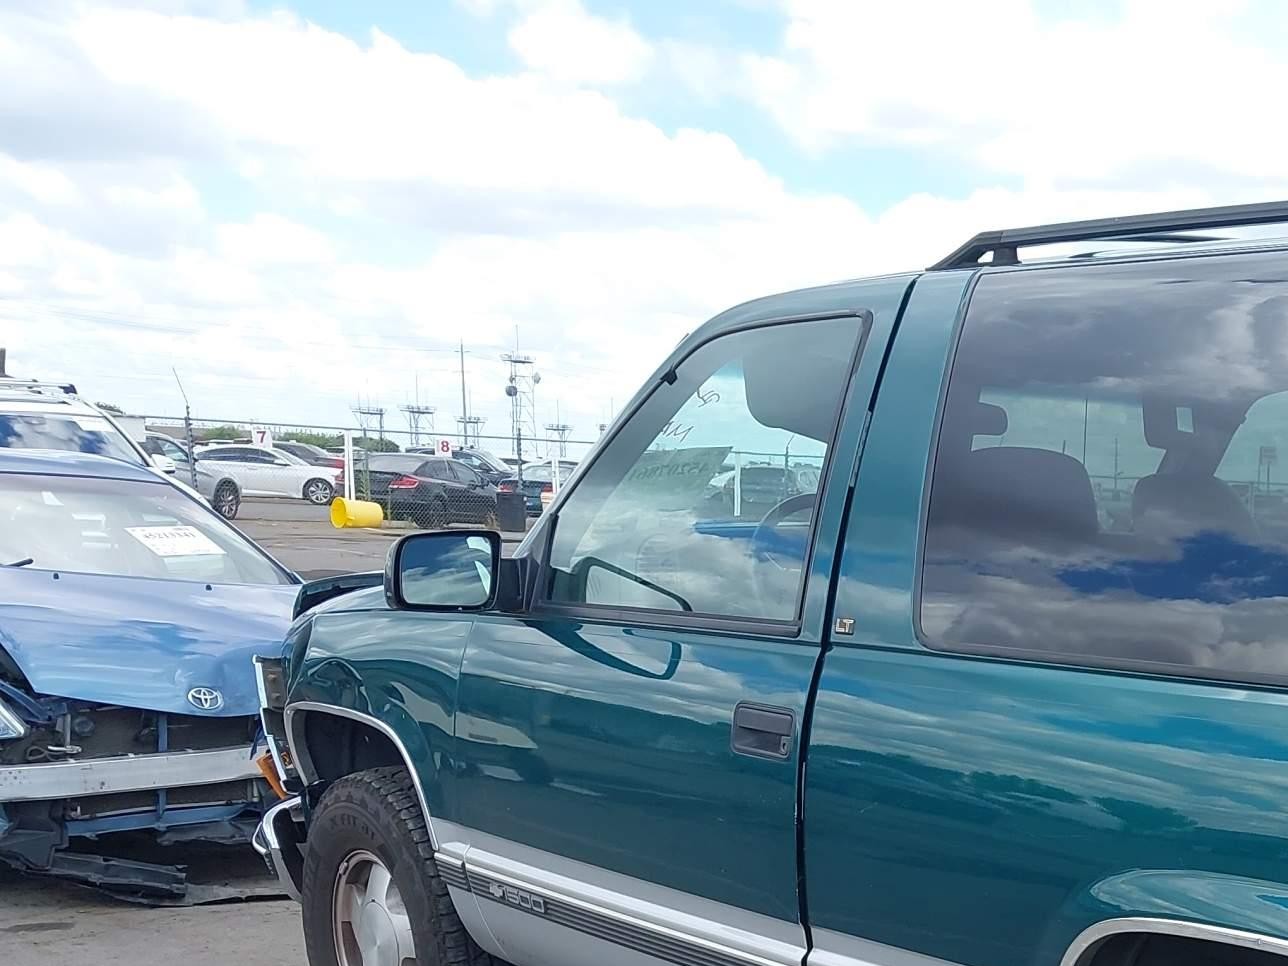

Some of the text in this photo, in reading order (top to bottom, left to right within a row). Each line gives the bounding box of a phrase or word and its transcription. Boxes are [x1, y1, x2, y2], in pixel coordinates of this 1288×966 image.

[256, 430, 266, 443] 7
[440, 440, 450, 452] 8
[835, 618, 854, 633] LT
